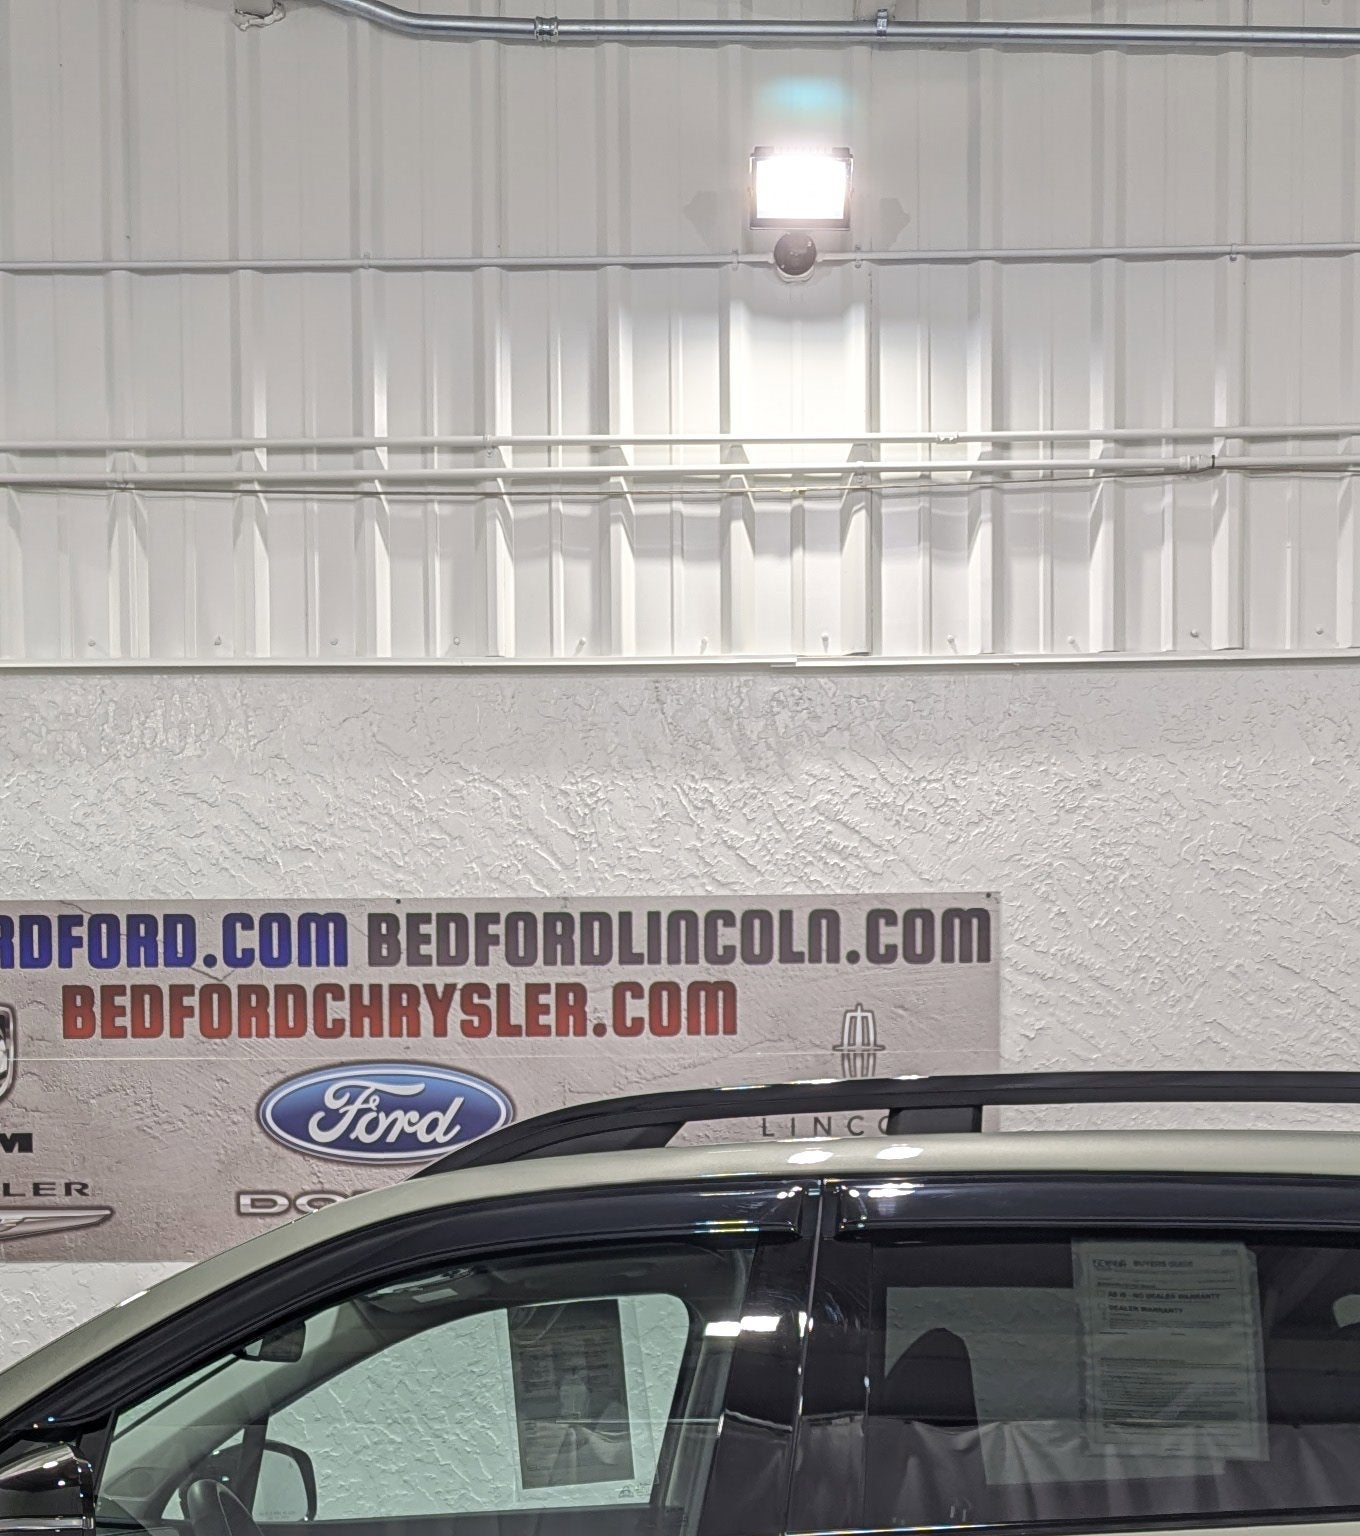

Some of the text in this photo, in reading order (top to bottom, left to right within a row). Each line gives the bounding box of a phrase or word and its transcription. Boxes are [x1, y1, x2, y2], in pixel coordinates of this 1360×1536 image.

[61, 979, 739, 1040] BEDFORDCHRYSLER.COM
[307, 1079, 465, 1144] Ford
[237, 1190, 366, 1217] DO
